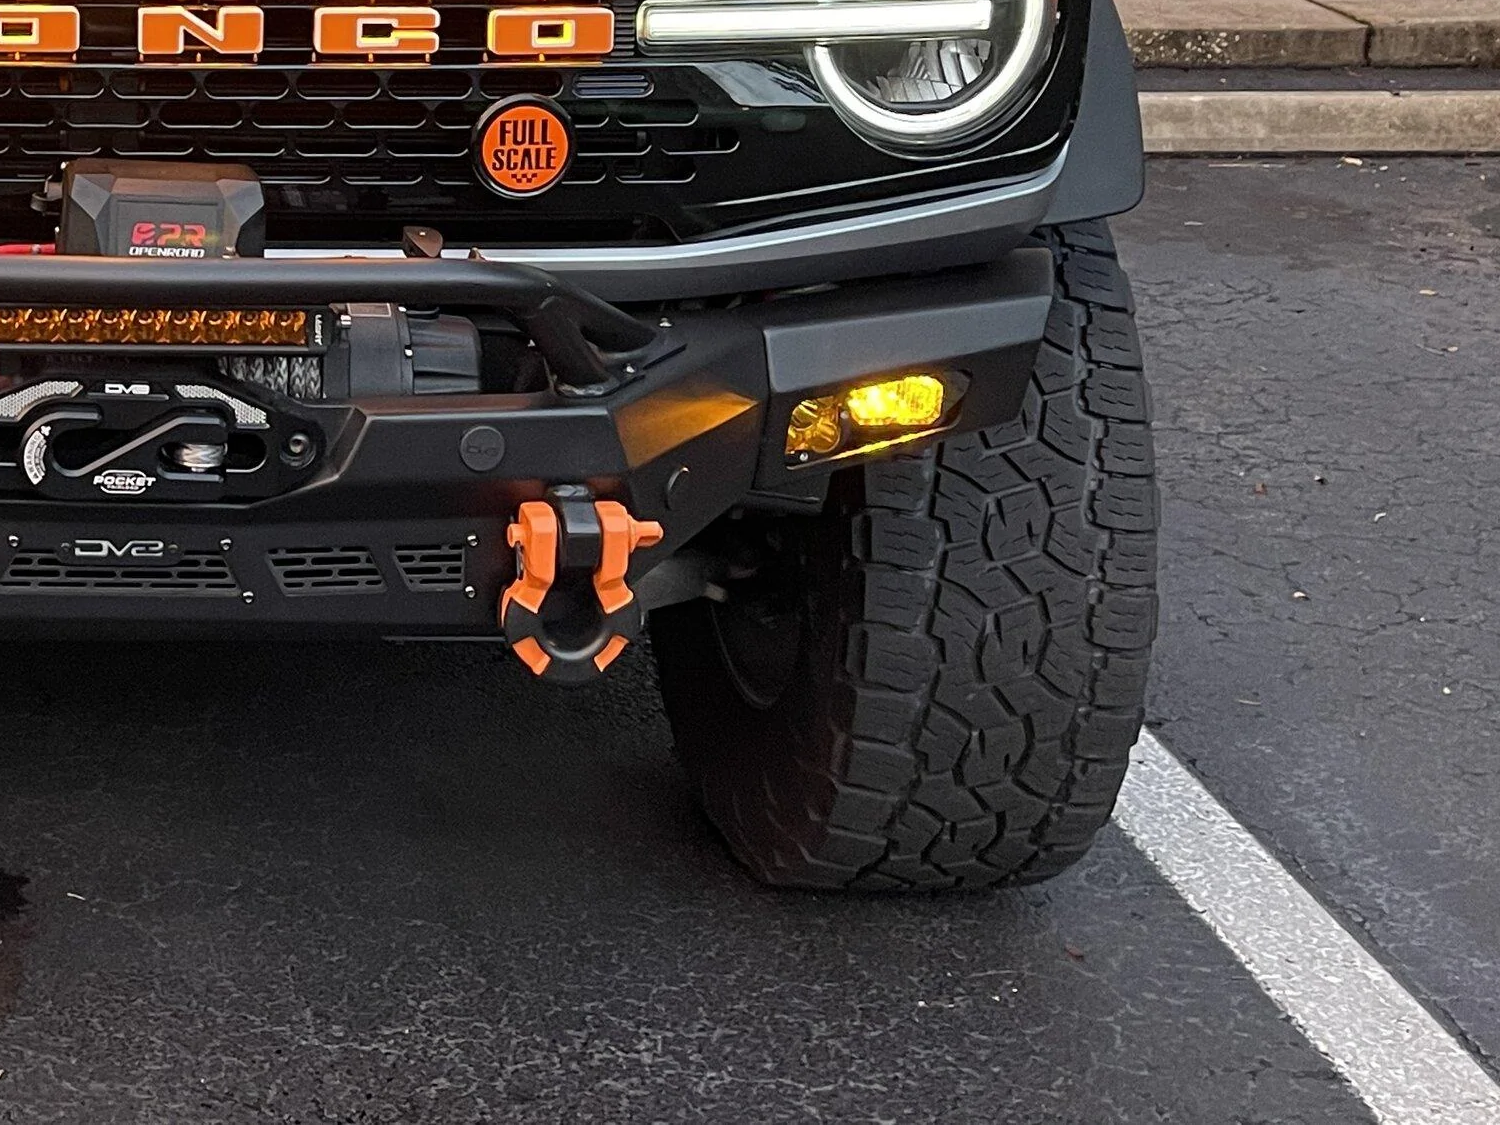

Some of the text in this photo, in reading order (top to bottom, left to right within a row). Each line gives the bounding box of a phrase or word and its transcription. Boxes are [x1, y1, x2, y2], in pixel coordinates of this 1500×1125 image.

[499, 119, 553, 146] FULL
[491, 147, 557, 171] SCALE
[128, 246, 205, 259] OPENROAD
[93, 475, 157, 487] POCKET
